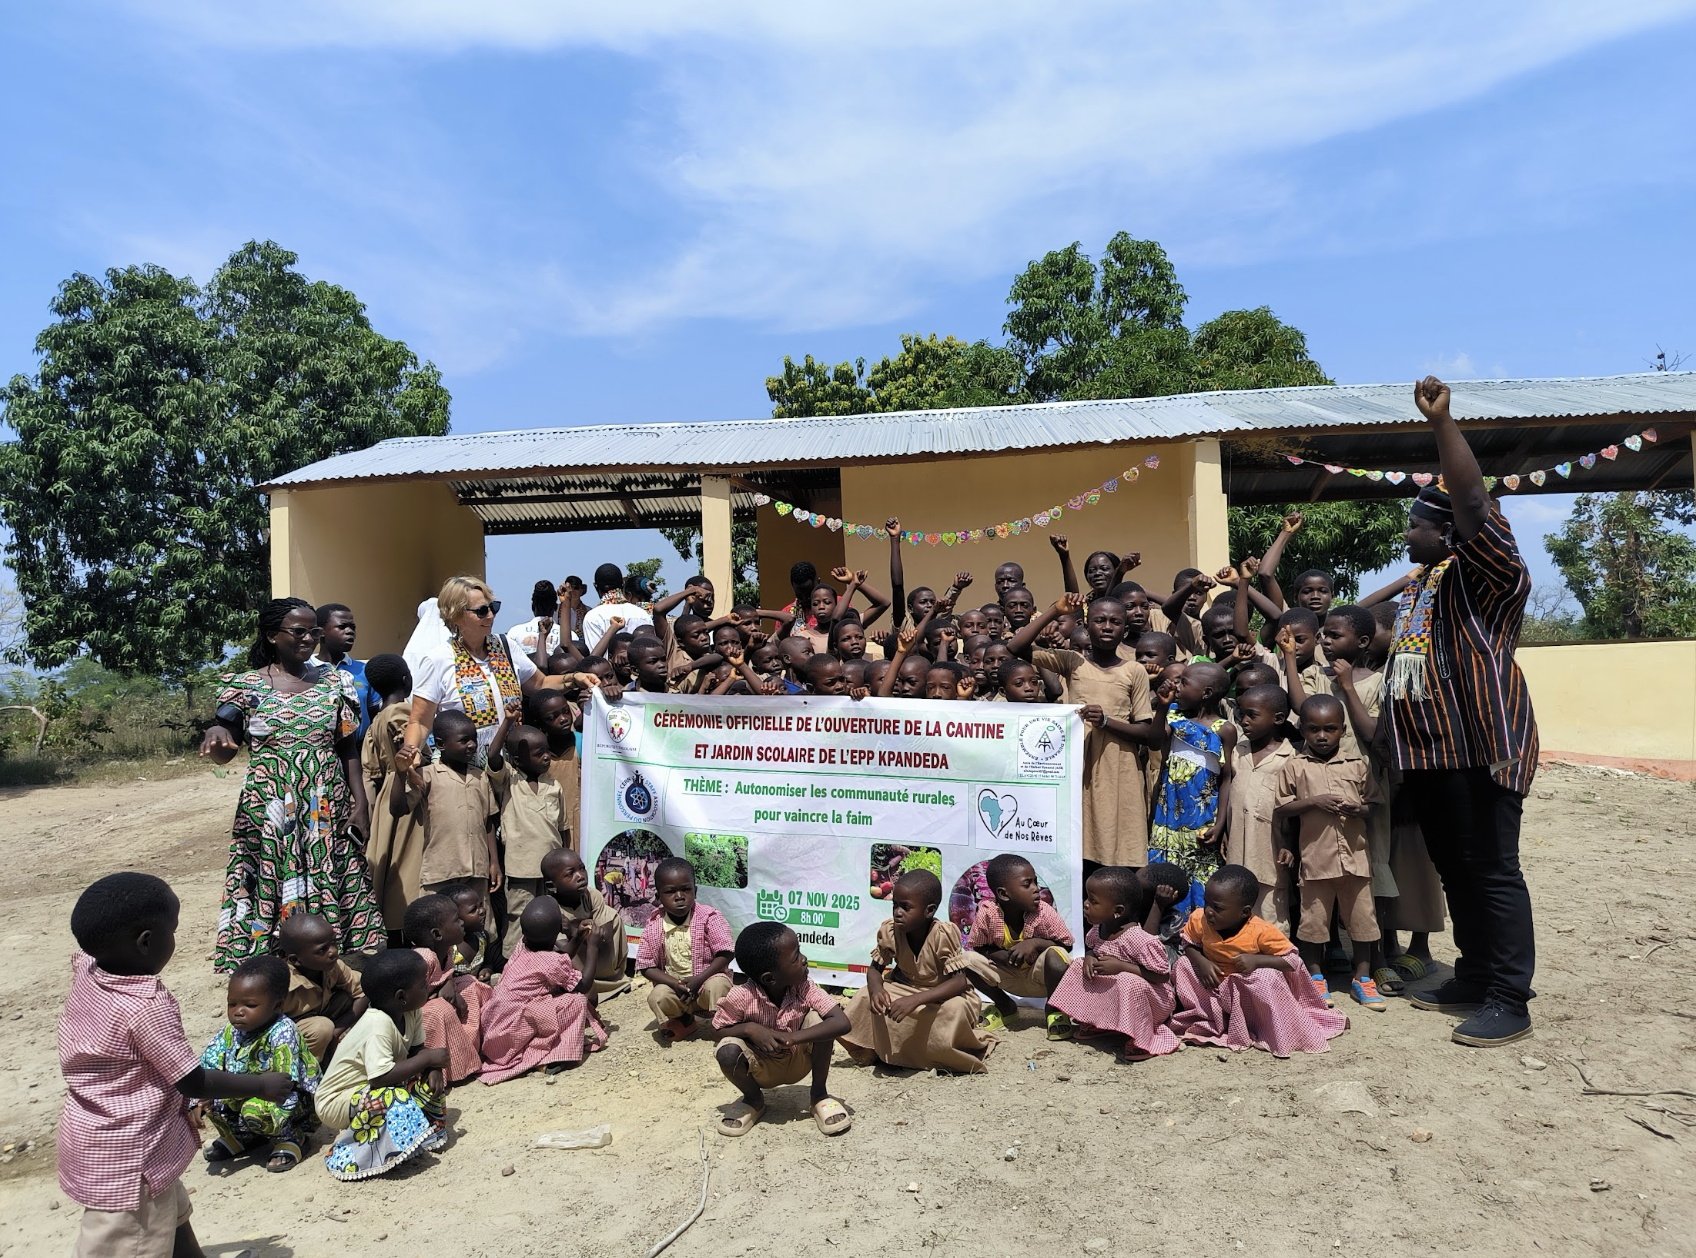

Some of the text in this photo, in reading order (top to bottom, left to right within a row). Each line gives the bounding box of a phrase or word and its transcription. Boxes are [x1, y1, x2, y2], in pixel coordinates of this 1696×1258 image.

[653, 711, 723, 730] CÉRÉMONIE
[726, 714, 793, 732] OFFICIELLE
[796, 716, 812, 732] DE
[904, 719, 922, 736] DE
[925, 720, 942, 737] LA
[946, 721, 1005, 739] CANTINE
[1019, 723, 1030, 737] POUR
[694, 743, 709, 759] ET
[711, 744, 753, 761] JARDIN
[757, 746, 815, 764] SCOLAIRE
[819, 748, 836, 764] DE
[878, 750, 949, 770] KPANDEDA
[619, 777, 632, 789] CERN
[644, 779, 657, 795] STAFF
[683, 776, 722, 793] THÈME
[735, 780, 807, 798] Autonomiser
[810, 783, 827, 799] les
[831, 787, 909, 803] communauté
[912, 789, 955, 806] rurales
[616, 790, 633, 820] PERSONNEL
[643, 796, 659, 822] ASSOCIATION
[754, 808, 873, 826] pour vaincre la faim
[1015, 817, 1048, 829] Au Cœur
[1004, 830, 1053, 843] de Nos Rêves
[788, 890, 860, 911] 07 NOV 2025
[800, 912, 811, 923] 8h
[796, 930, 835, 946] andeda
